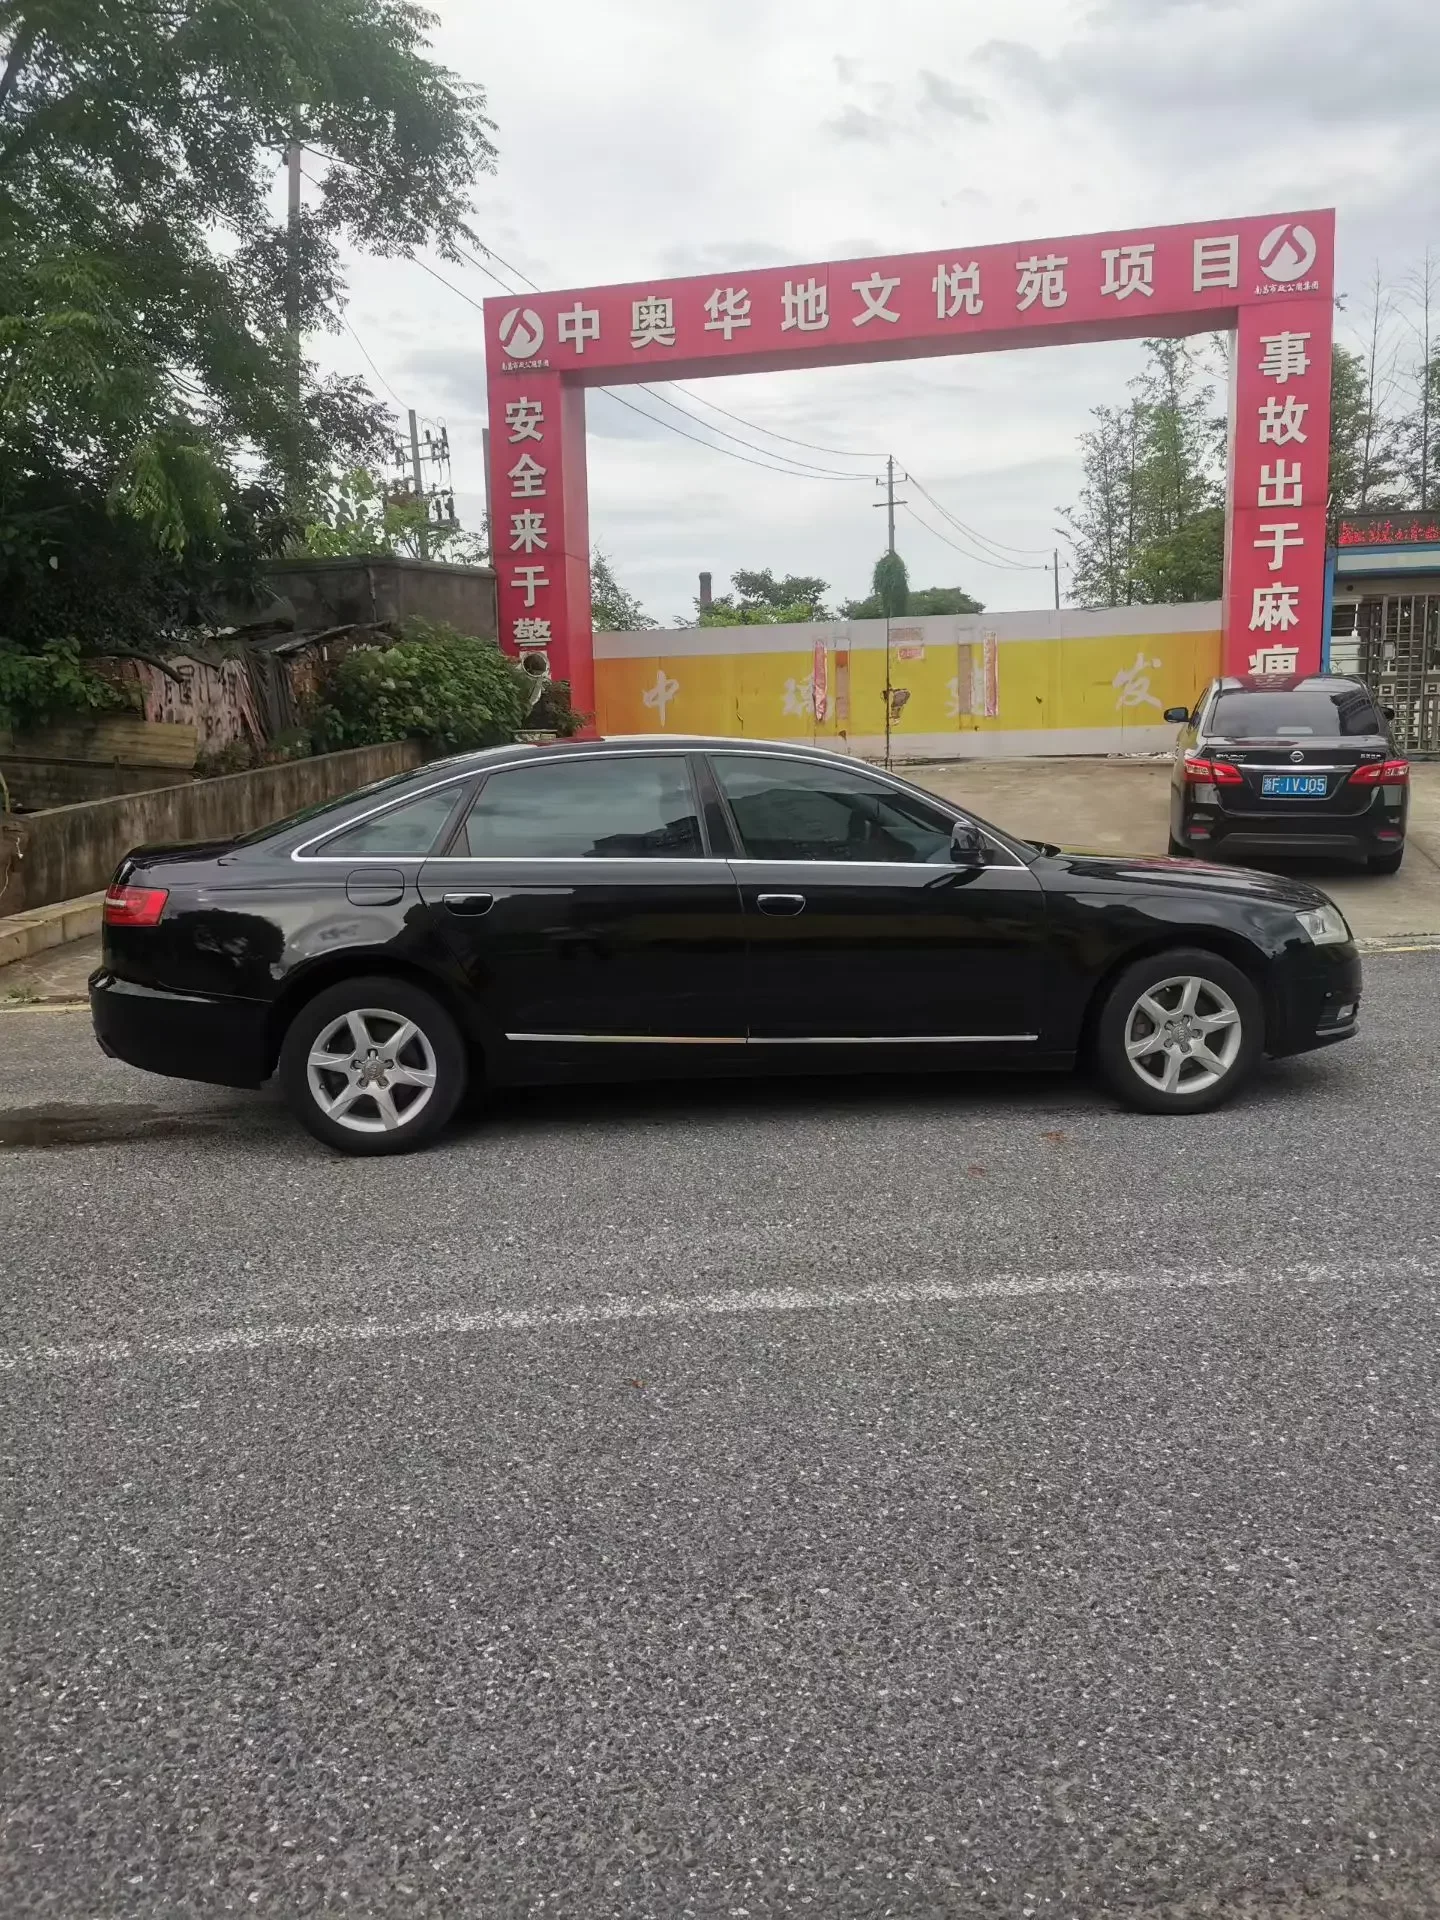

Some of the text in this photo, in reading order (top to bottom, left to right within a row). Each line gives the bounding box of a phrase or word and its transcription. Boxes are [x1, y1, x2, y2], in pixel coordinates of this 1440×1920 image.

[557, 234, 1239, 355] 中奥华地文悦苑项目
